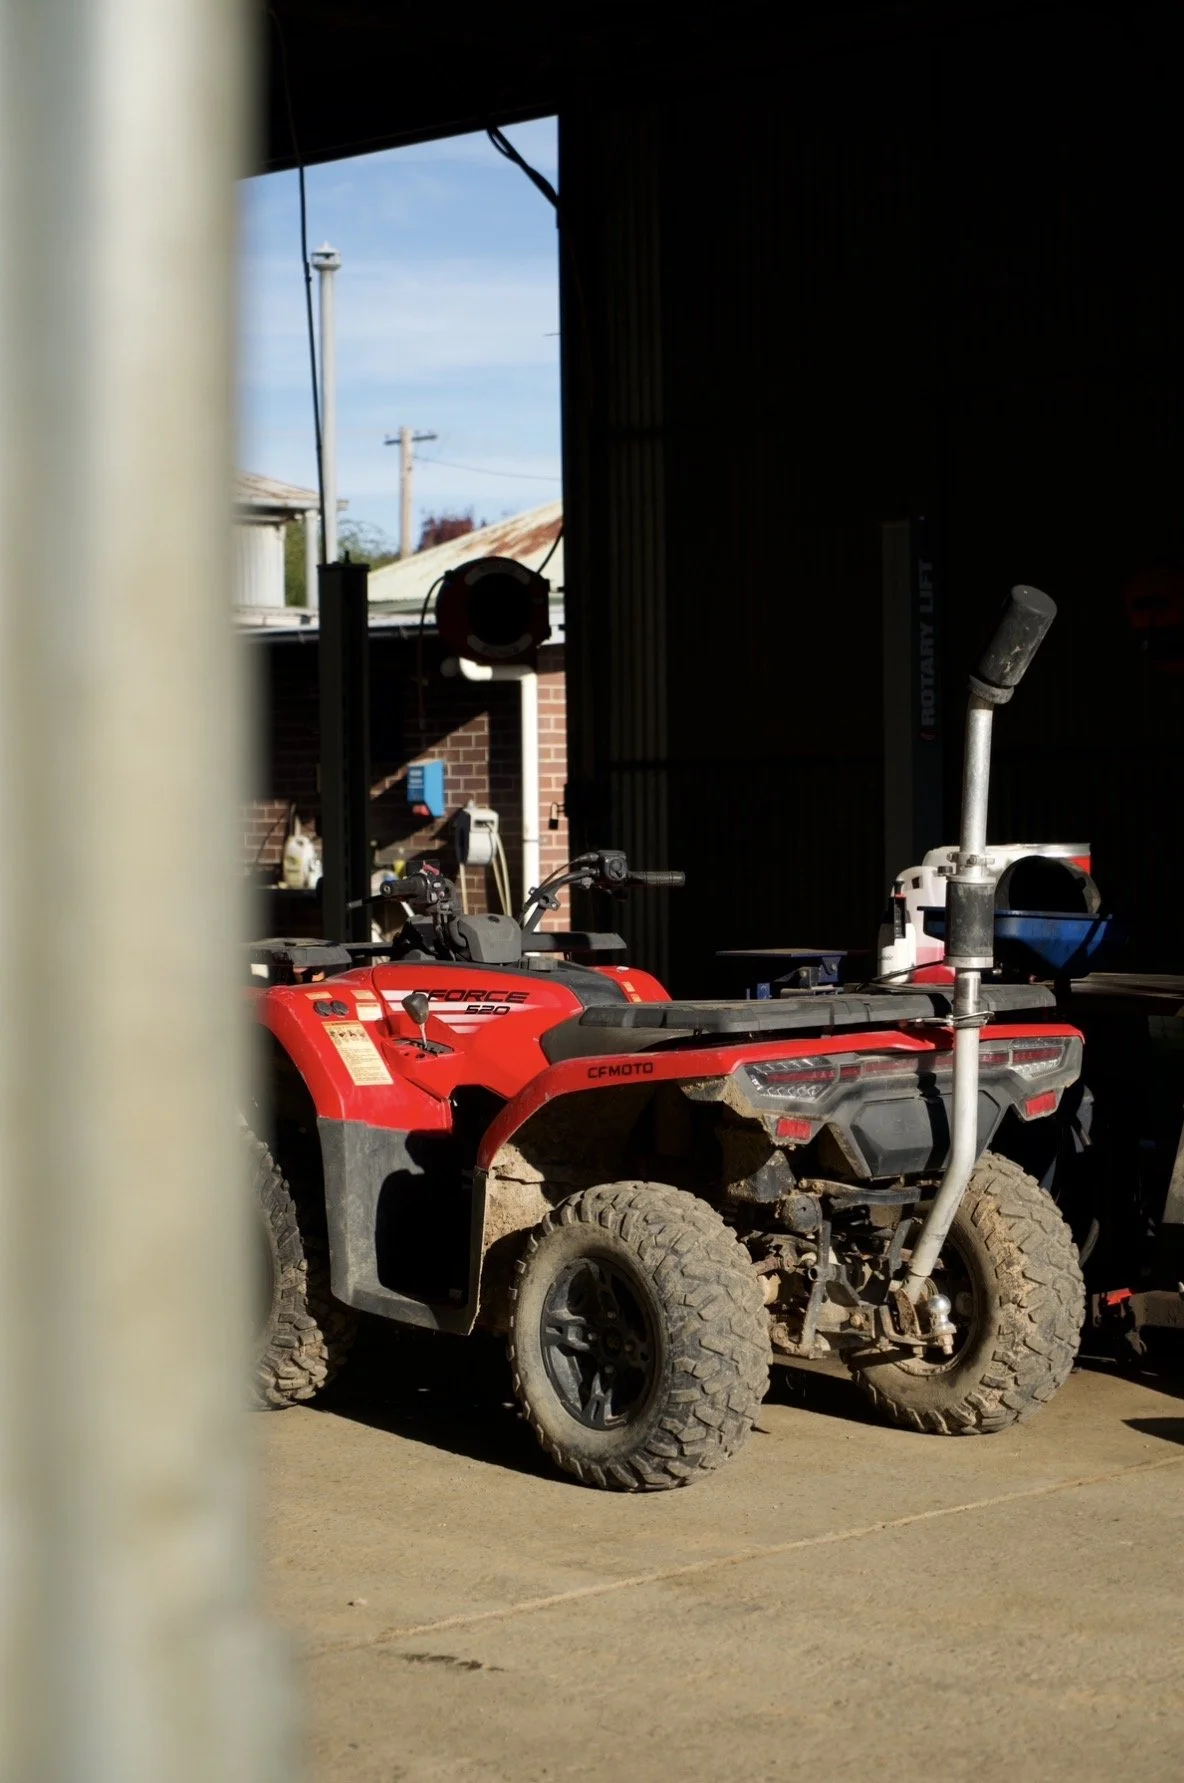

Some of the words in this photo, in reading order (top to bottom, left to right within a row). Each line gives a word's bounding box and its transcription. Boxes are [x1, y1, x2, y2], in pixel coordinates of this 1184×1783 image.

[917, 559, 934, 613] LIFT
[918, 621, 935, 727] ROTARY
[464, 1004, 511, 1016] 520
[587, 1061, 654, 1079] CFMOTO
